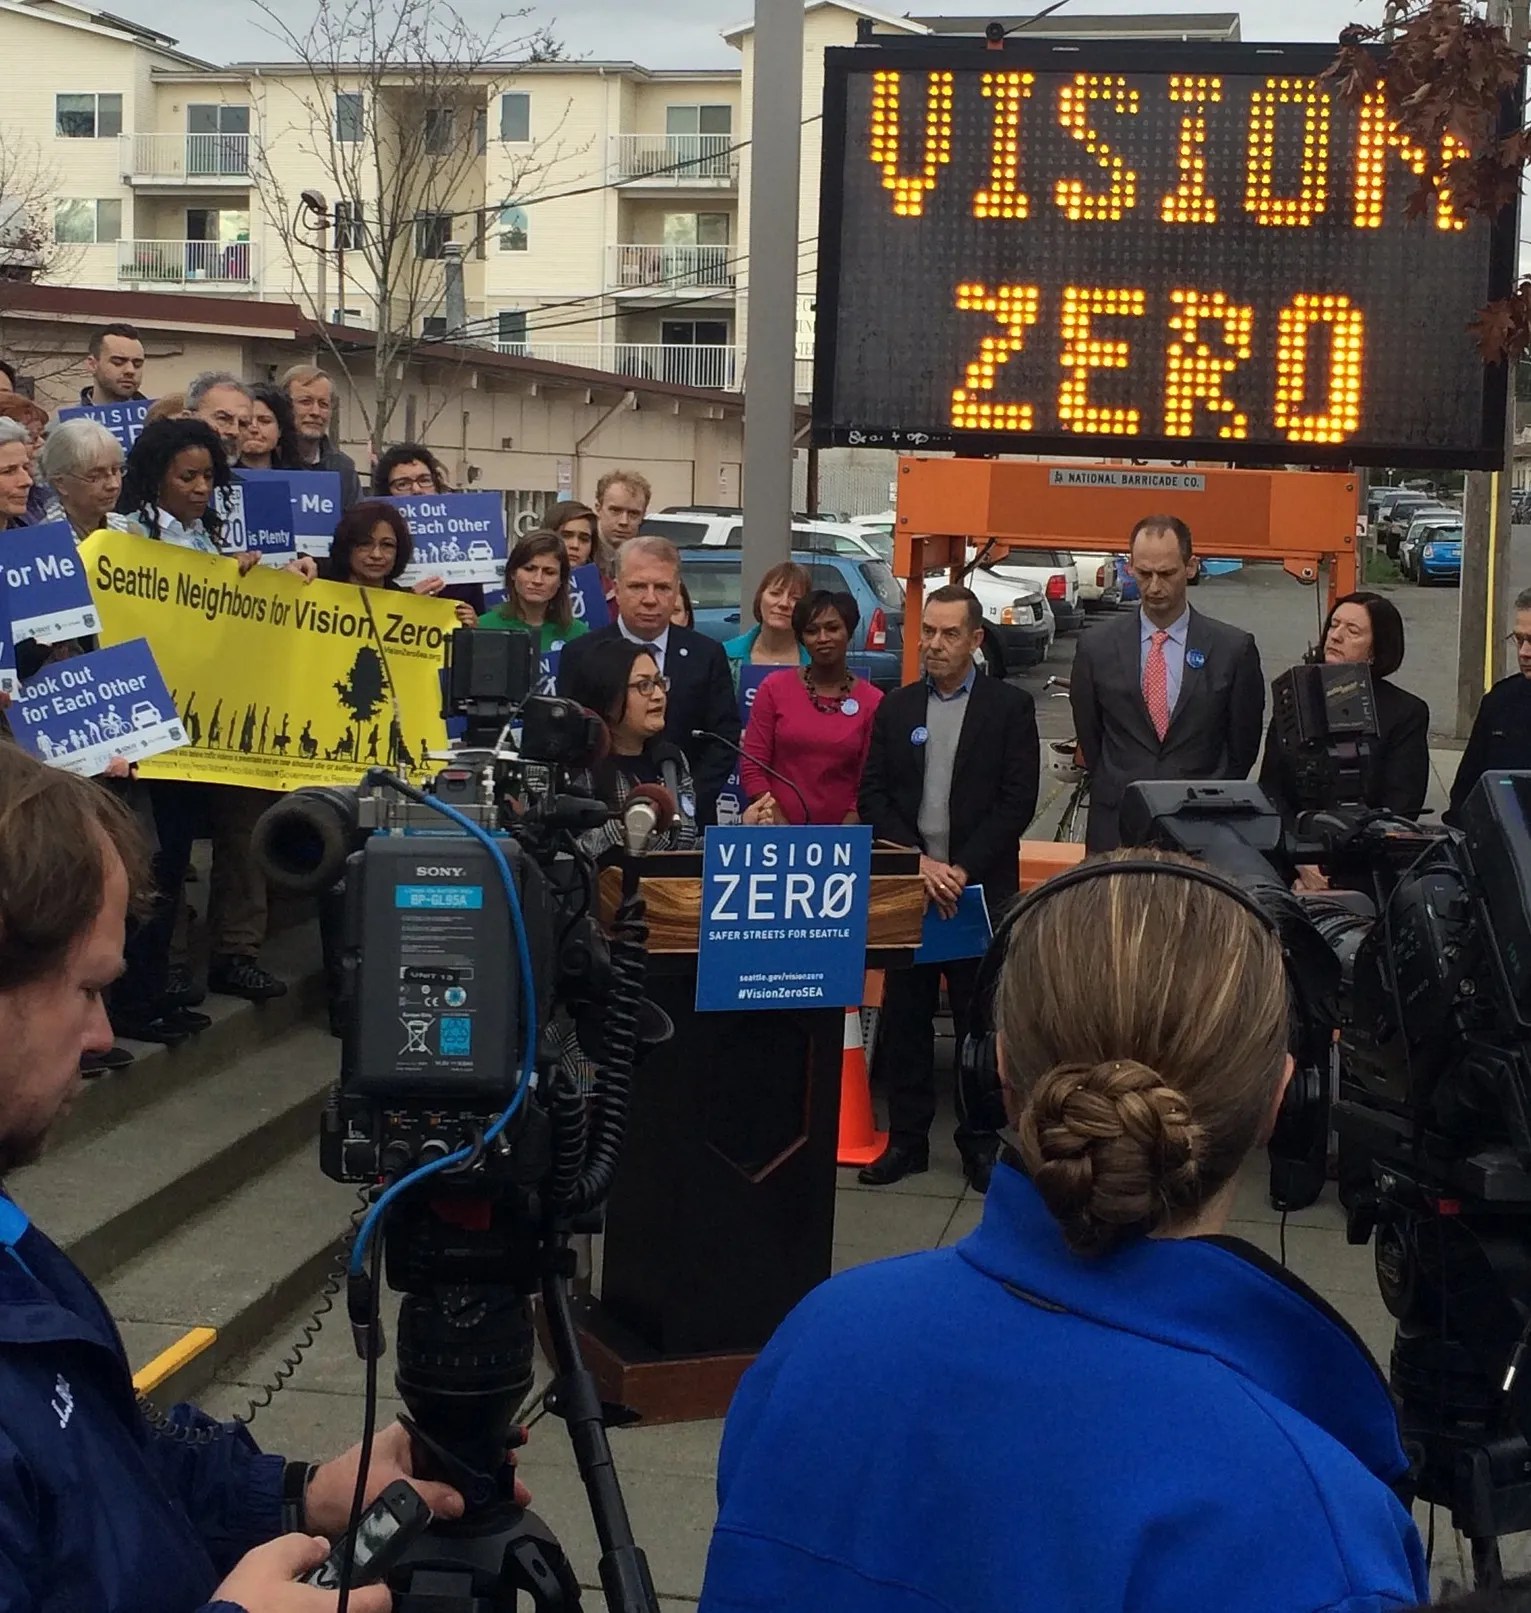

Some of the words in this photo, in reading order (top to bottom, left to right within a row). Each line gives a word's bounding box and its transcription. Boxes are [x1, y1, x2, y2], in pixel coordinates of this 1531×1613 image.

[866, 70, 1471, 231] VISION
[949, 283, 1367, 445] ZERO
[84, 406, 148, 425] VISIO
[1068, 473, 1117, 485] NATIONAL
[1121, 475, 1178, 487] BARRICADE
[1183, 476, 1200, 488] CO.
[301, 493, 334, 514] Me
[420, 503, 448, 518] Out
[408, 520, 444, 535] Each
[447, 518, 491, 534] Other
[247, 530, 258, 547] is
[258, 528, 290, 547] Plenty
[35, 554, 76, 582] Me
[96, 554, 170, 603] Seattle
[175, 572, 268, 621] Neighbors
[269, 593, 291, 626] for
[295, 599, 376, 640] Vision
[382, 613, 443, 649] Zero
[18, 677, 61, 704] Look
[61, 666, 95, 689] Out
[22, 705, 49, 725] for
[51, 691, 97, 715] Each
[98, 674, 148, 700] Other
[718, 843, 851, 868] VISION
[416, 866, 464, 877] SONY
[708, 930, 741, 941] SAFER
[743, 929, 786, 940] STREETS
[788, 929, 807, 939] FOR
[809, 928, 850, 938] SEATTLE
[410, 971, 436, 980] UNIT
[739, 972, 824, 983] seattle.gov/visionzero
[738, 986, 824, 1000] #VisionZeroSEA
